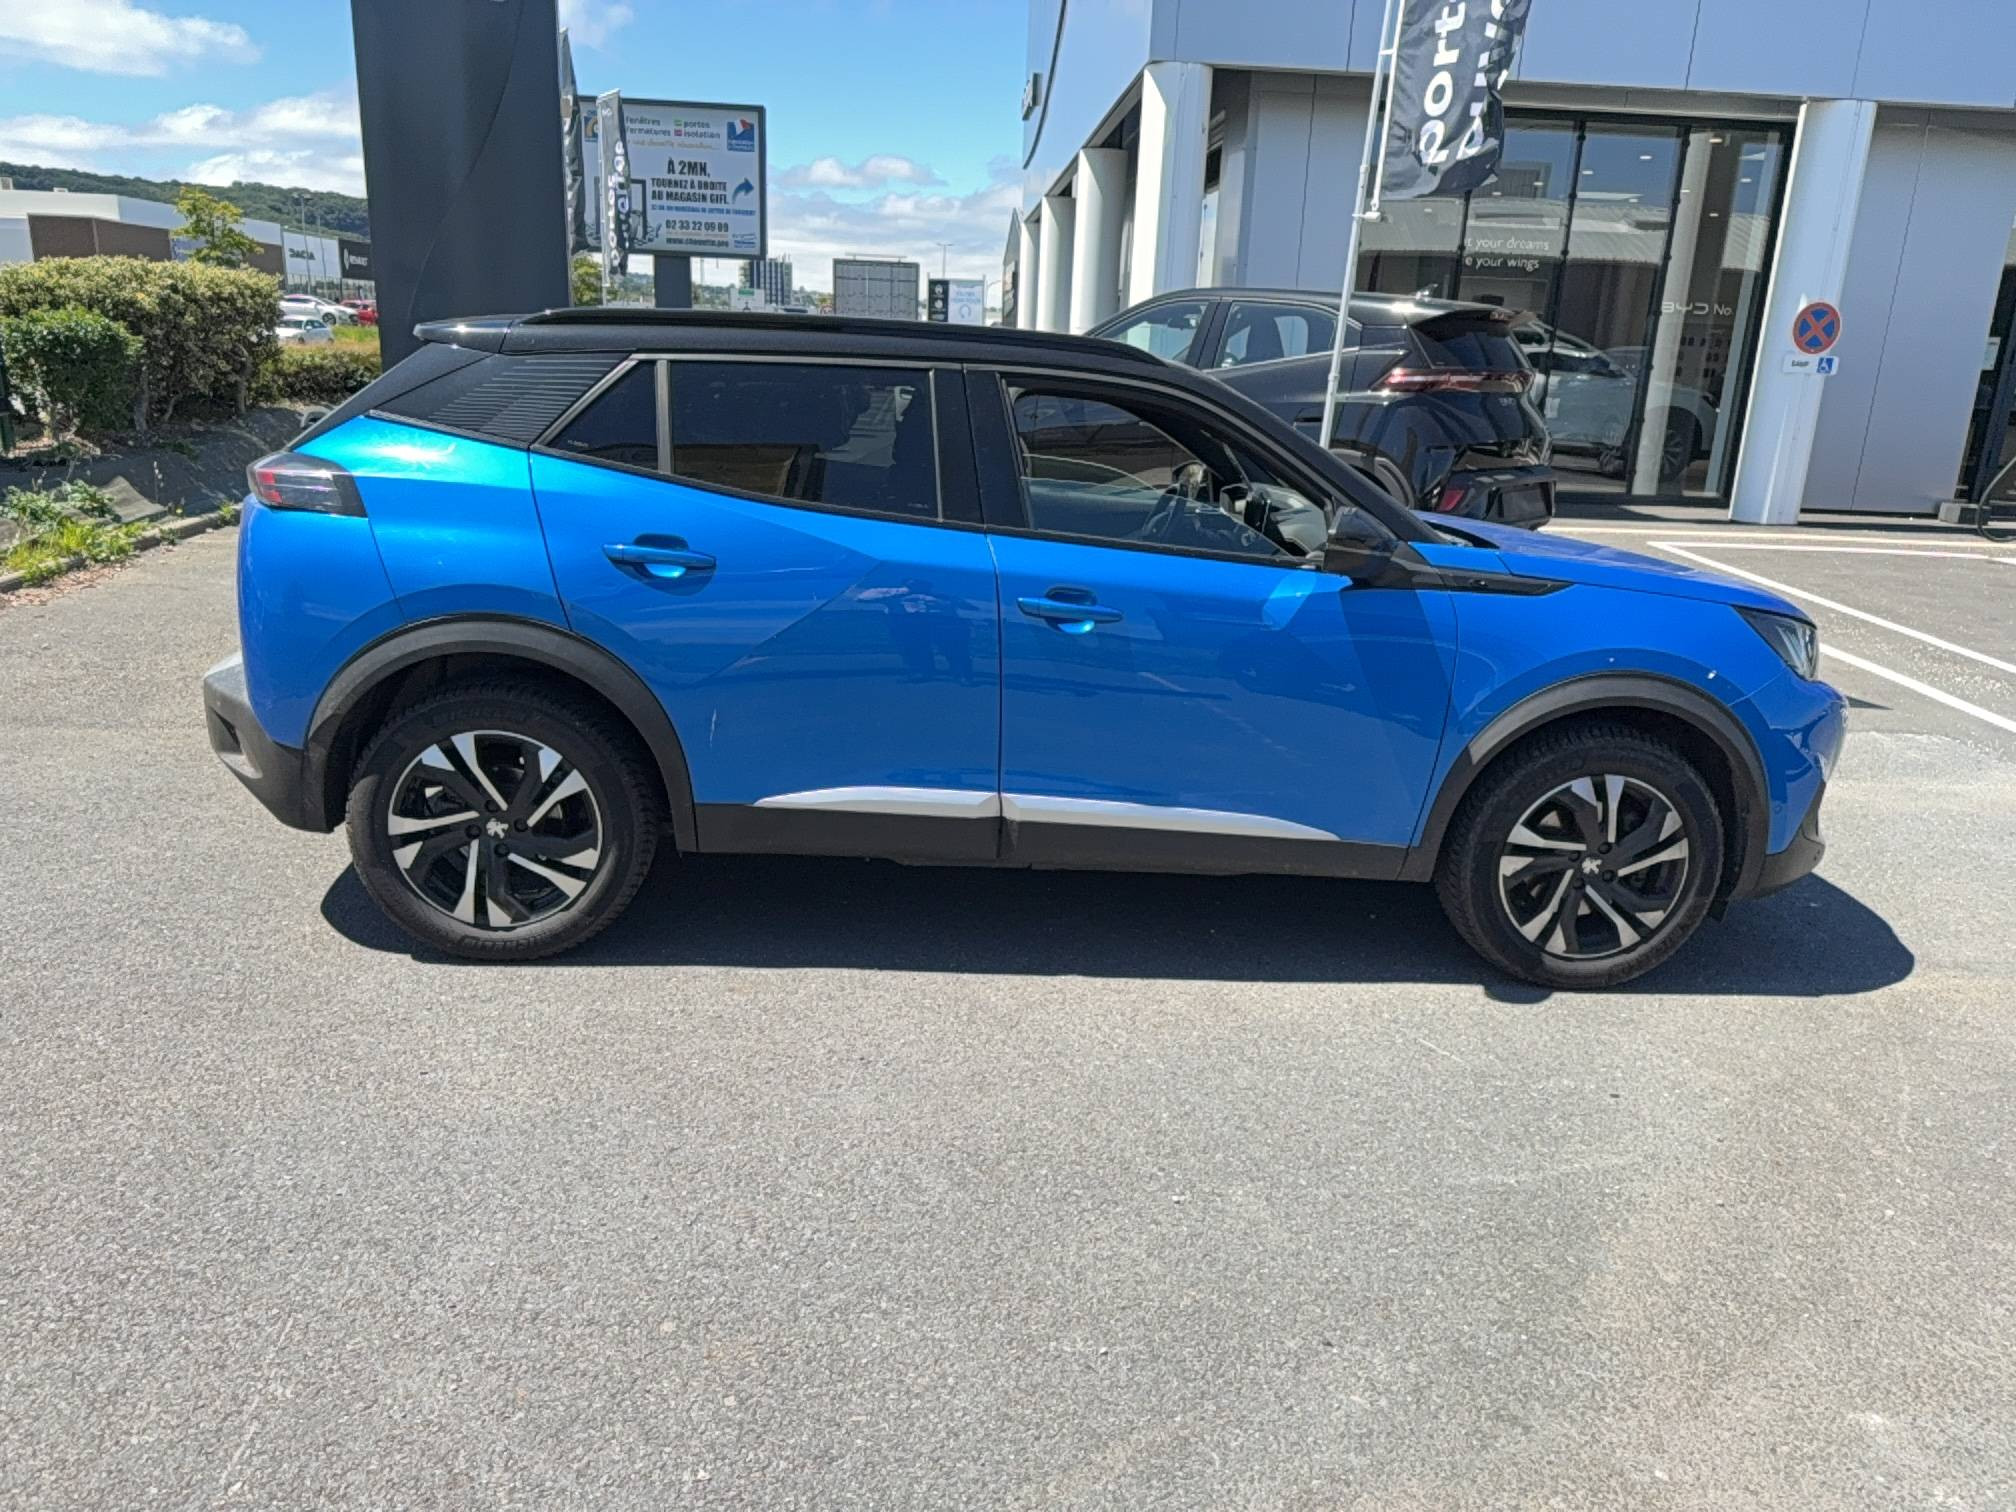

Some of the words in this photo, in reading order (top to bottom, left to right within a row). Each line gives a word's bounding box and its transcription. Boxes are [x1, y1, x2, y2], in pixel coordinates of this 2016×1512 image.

[1419, 0, 1466, 164] port
[667, 156, 676, 175] À
[651, 178, 688, 190] TOURNEZ
[698, 180, 728, 192] DROITE
[651, 190, 663, 201] AU
[666, 190, 707, 203] MAGASIN
[692, 221, 702, 231] 22
[1475, 239, 1504, 251] your
[1506, 236, 1550, 250] dreams
[1475, 257, 1504, 270] your
[1507, 257, 1540, 272] wings
[1662, 302, 1709, 315] BYD
